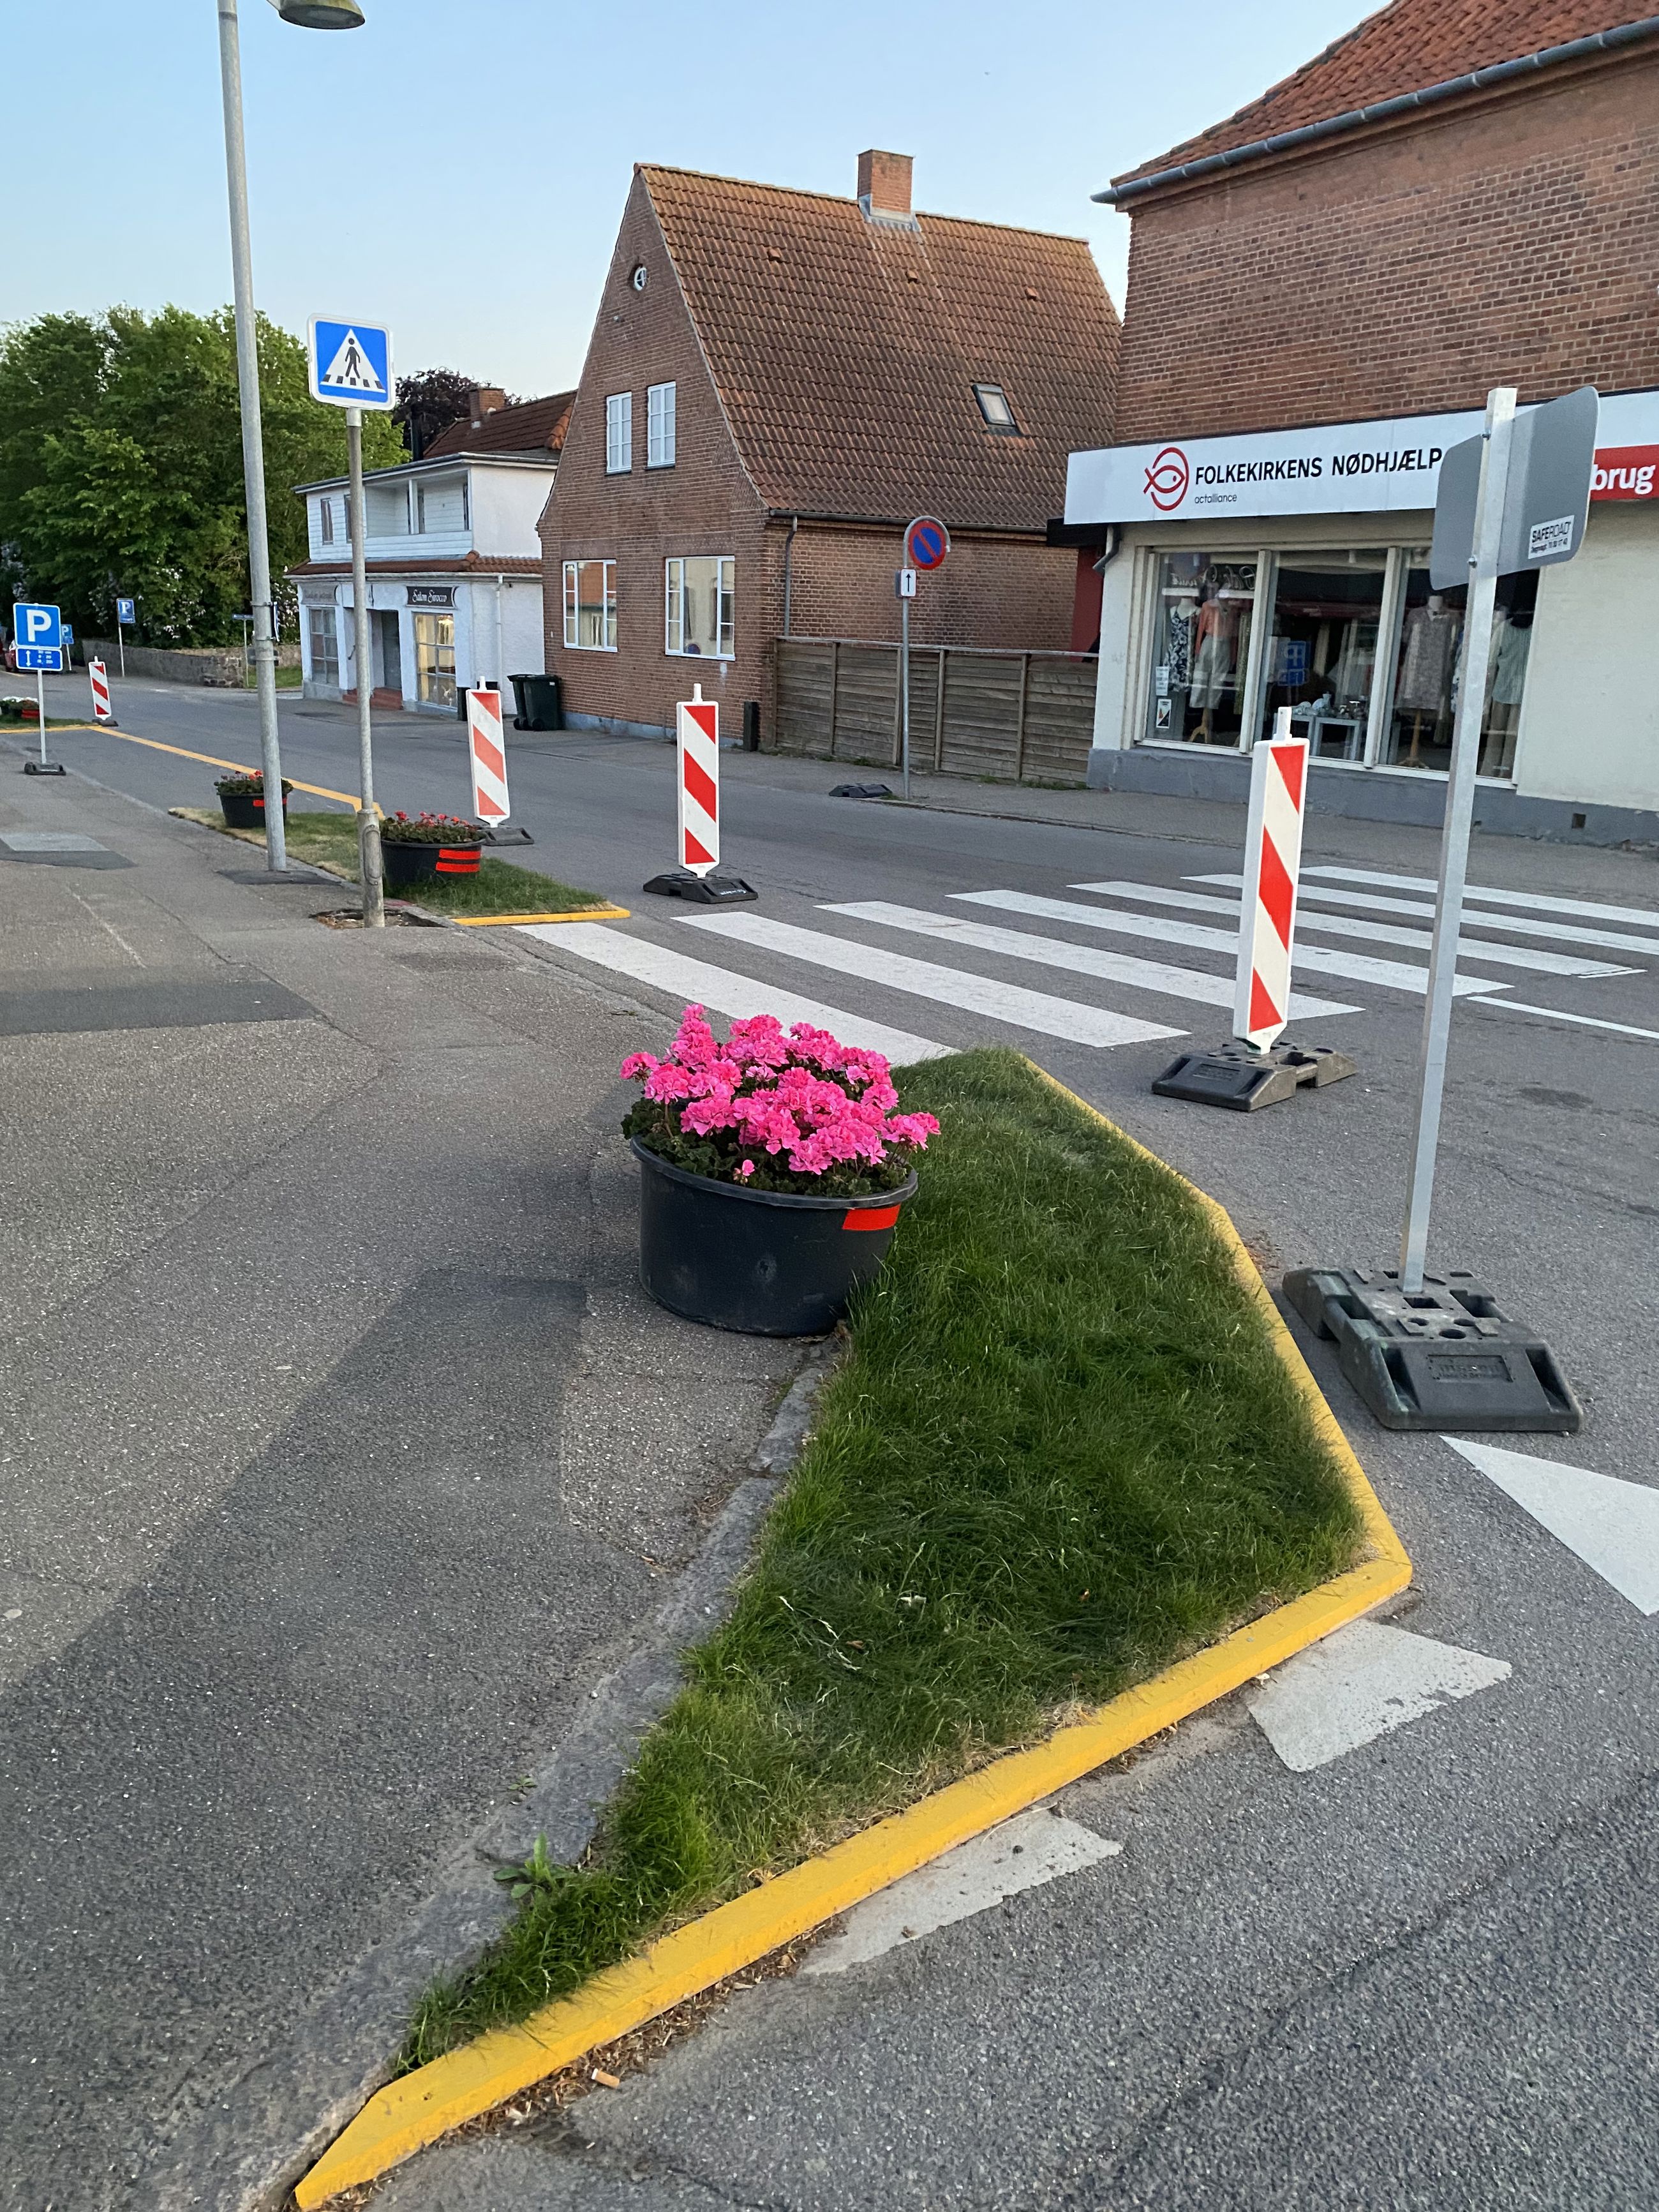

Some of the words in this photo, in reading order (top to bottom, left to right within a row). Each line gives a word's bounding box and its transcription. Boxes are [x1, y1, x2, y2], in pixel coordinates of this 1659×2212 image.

[1195, 457, 1323, 485] FOLKEKIRKENS
[1332, 448, 1443, 476] NØDHJÆLP
[121, 602, 131, 613] P
[26, 609, 51, 642] P
[61, 626, 69, 636] P
